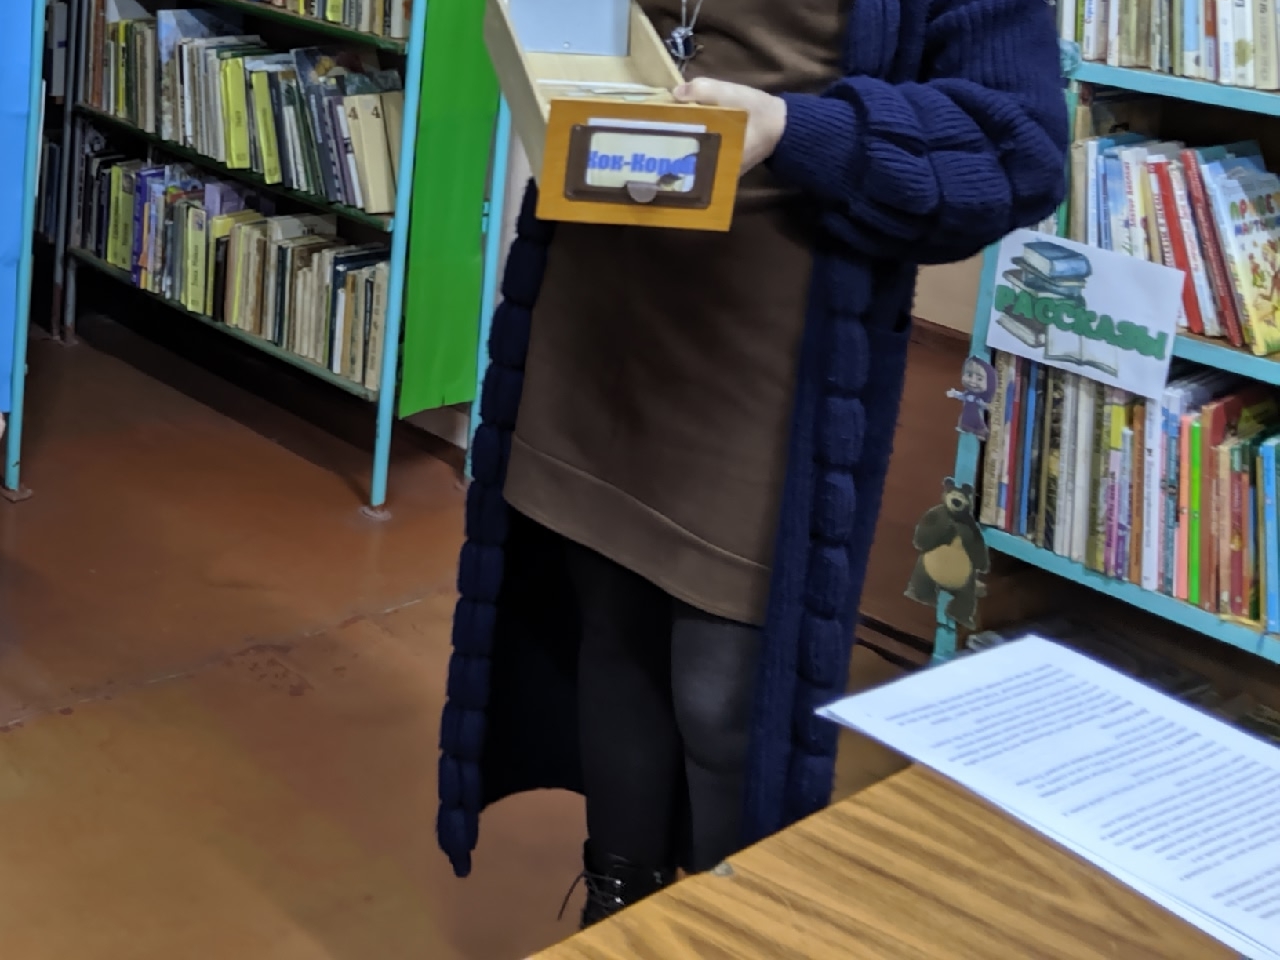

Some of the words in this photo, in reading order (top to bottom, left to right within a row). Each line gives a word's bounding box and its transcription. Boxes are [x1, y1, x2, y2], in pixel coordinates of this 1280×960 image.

[348, 106, 359, 120] 4
[371, 105, 381, 119] 4
[994, 284, 1169, 360] РАССКАЗЫ
